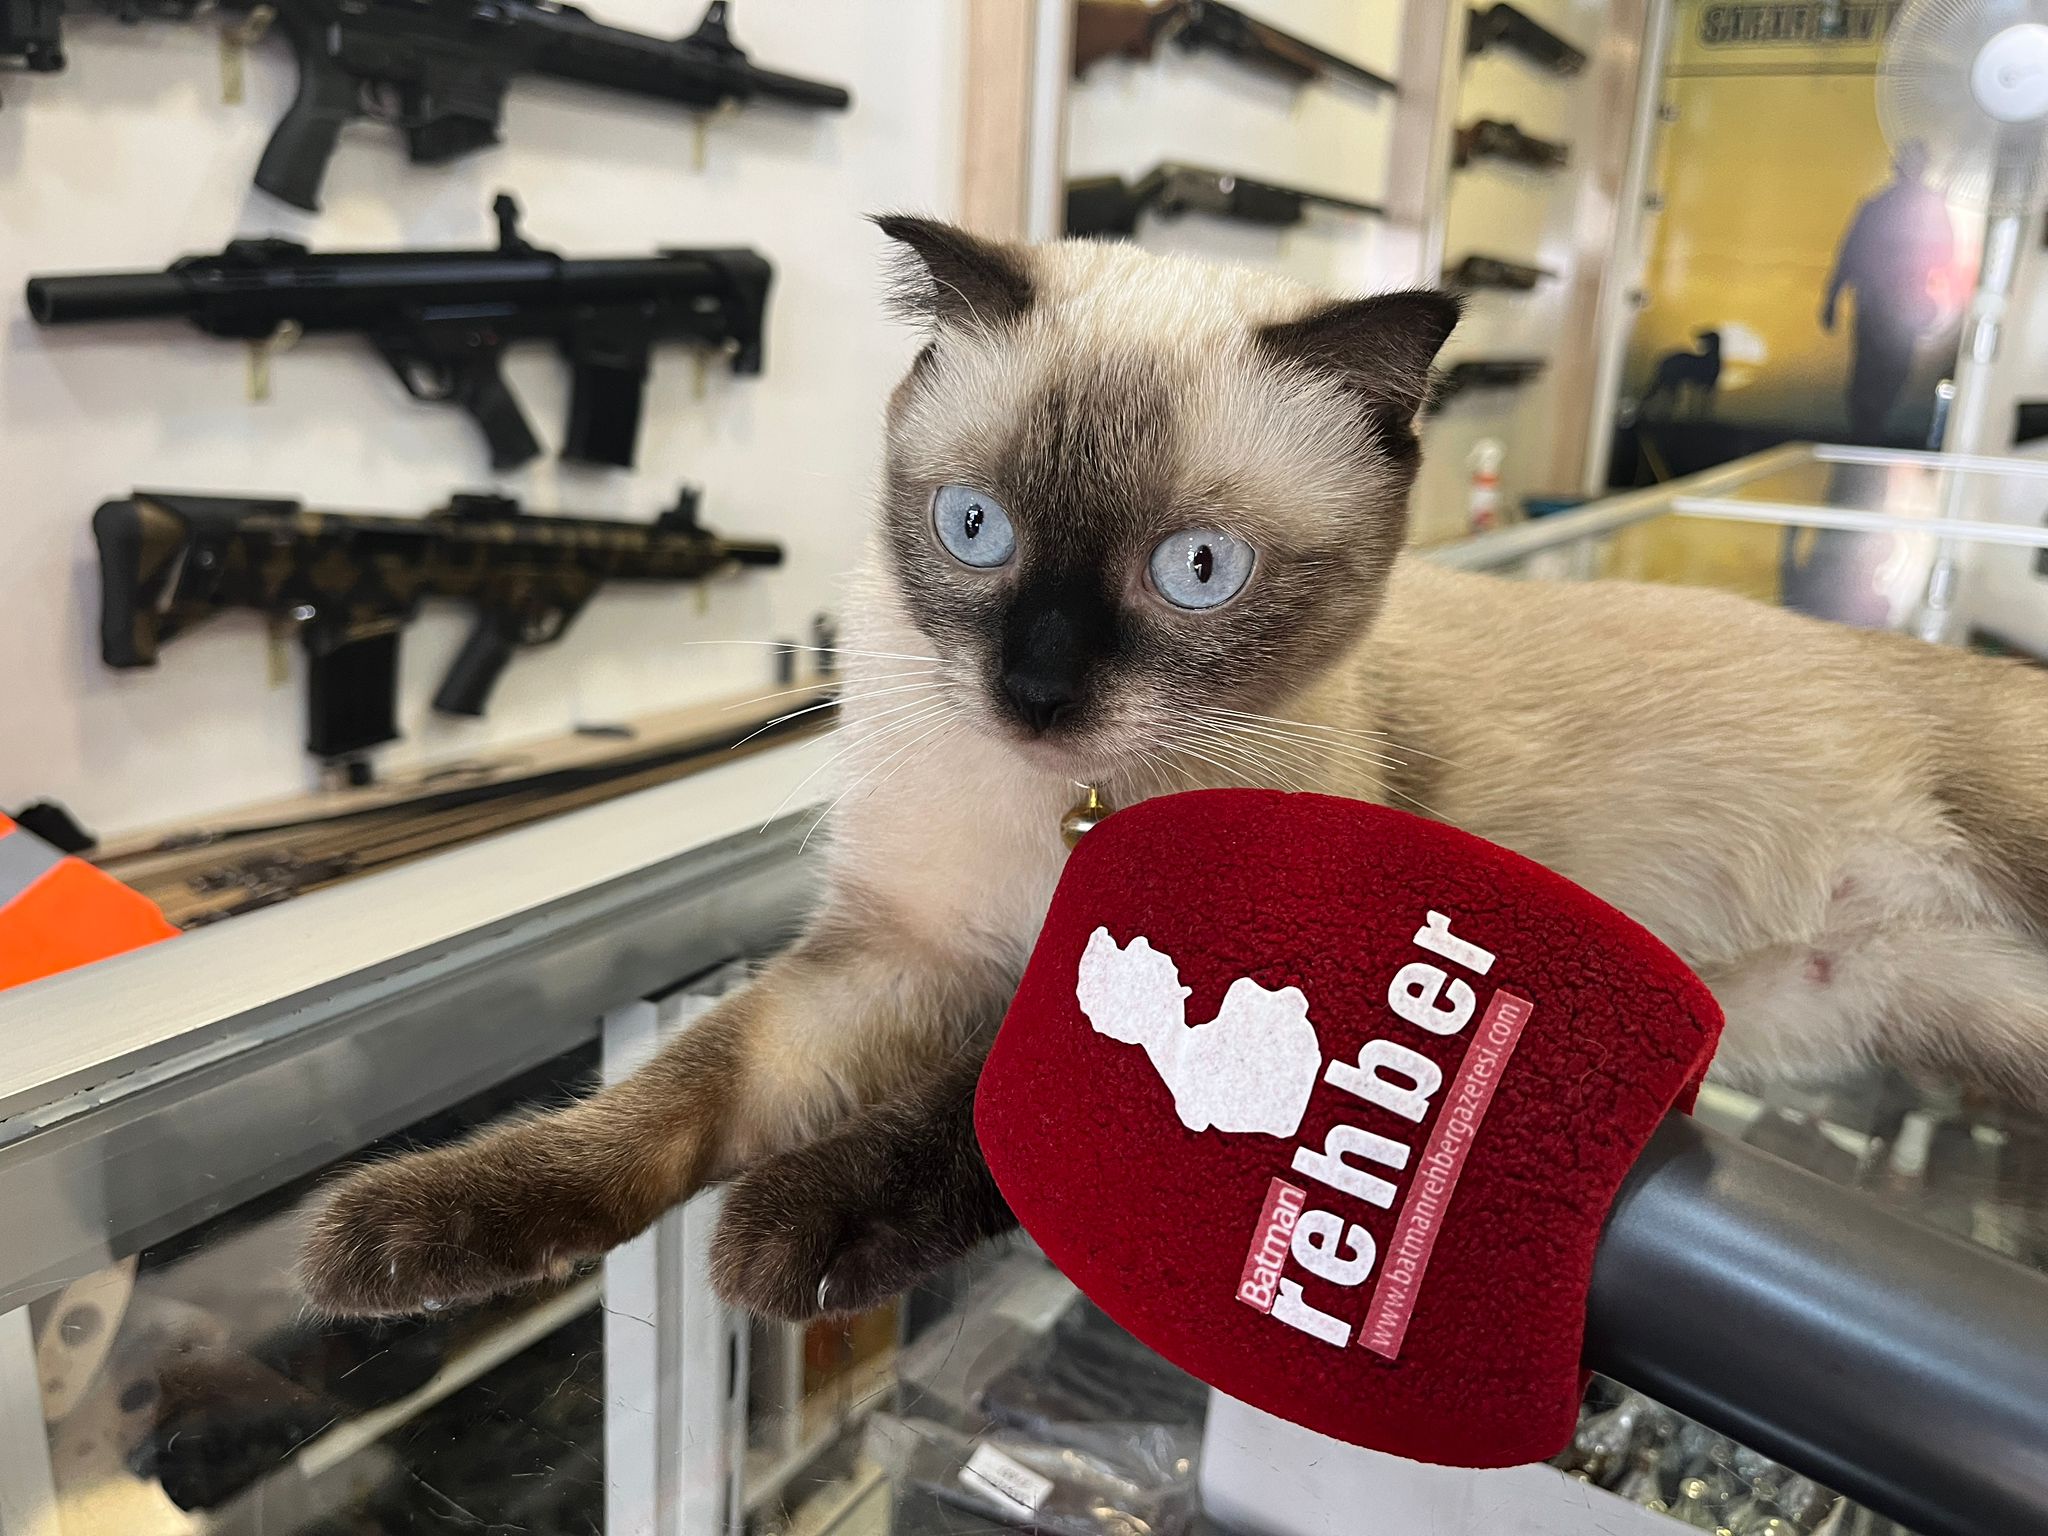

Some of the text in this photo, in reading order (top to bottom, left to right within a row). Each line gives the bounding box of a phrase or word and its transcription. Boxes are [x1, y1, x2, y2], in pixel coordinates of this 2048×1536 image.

[1240, 1186, 1306, 1310] Batman
[1270, 909, 1497, 1349] rehber
[1370, 1002, 1523, 1349] www.batmanrehbergazetesi.com
